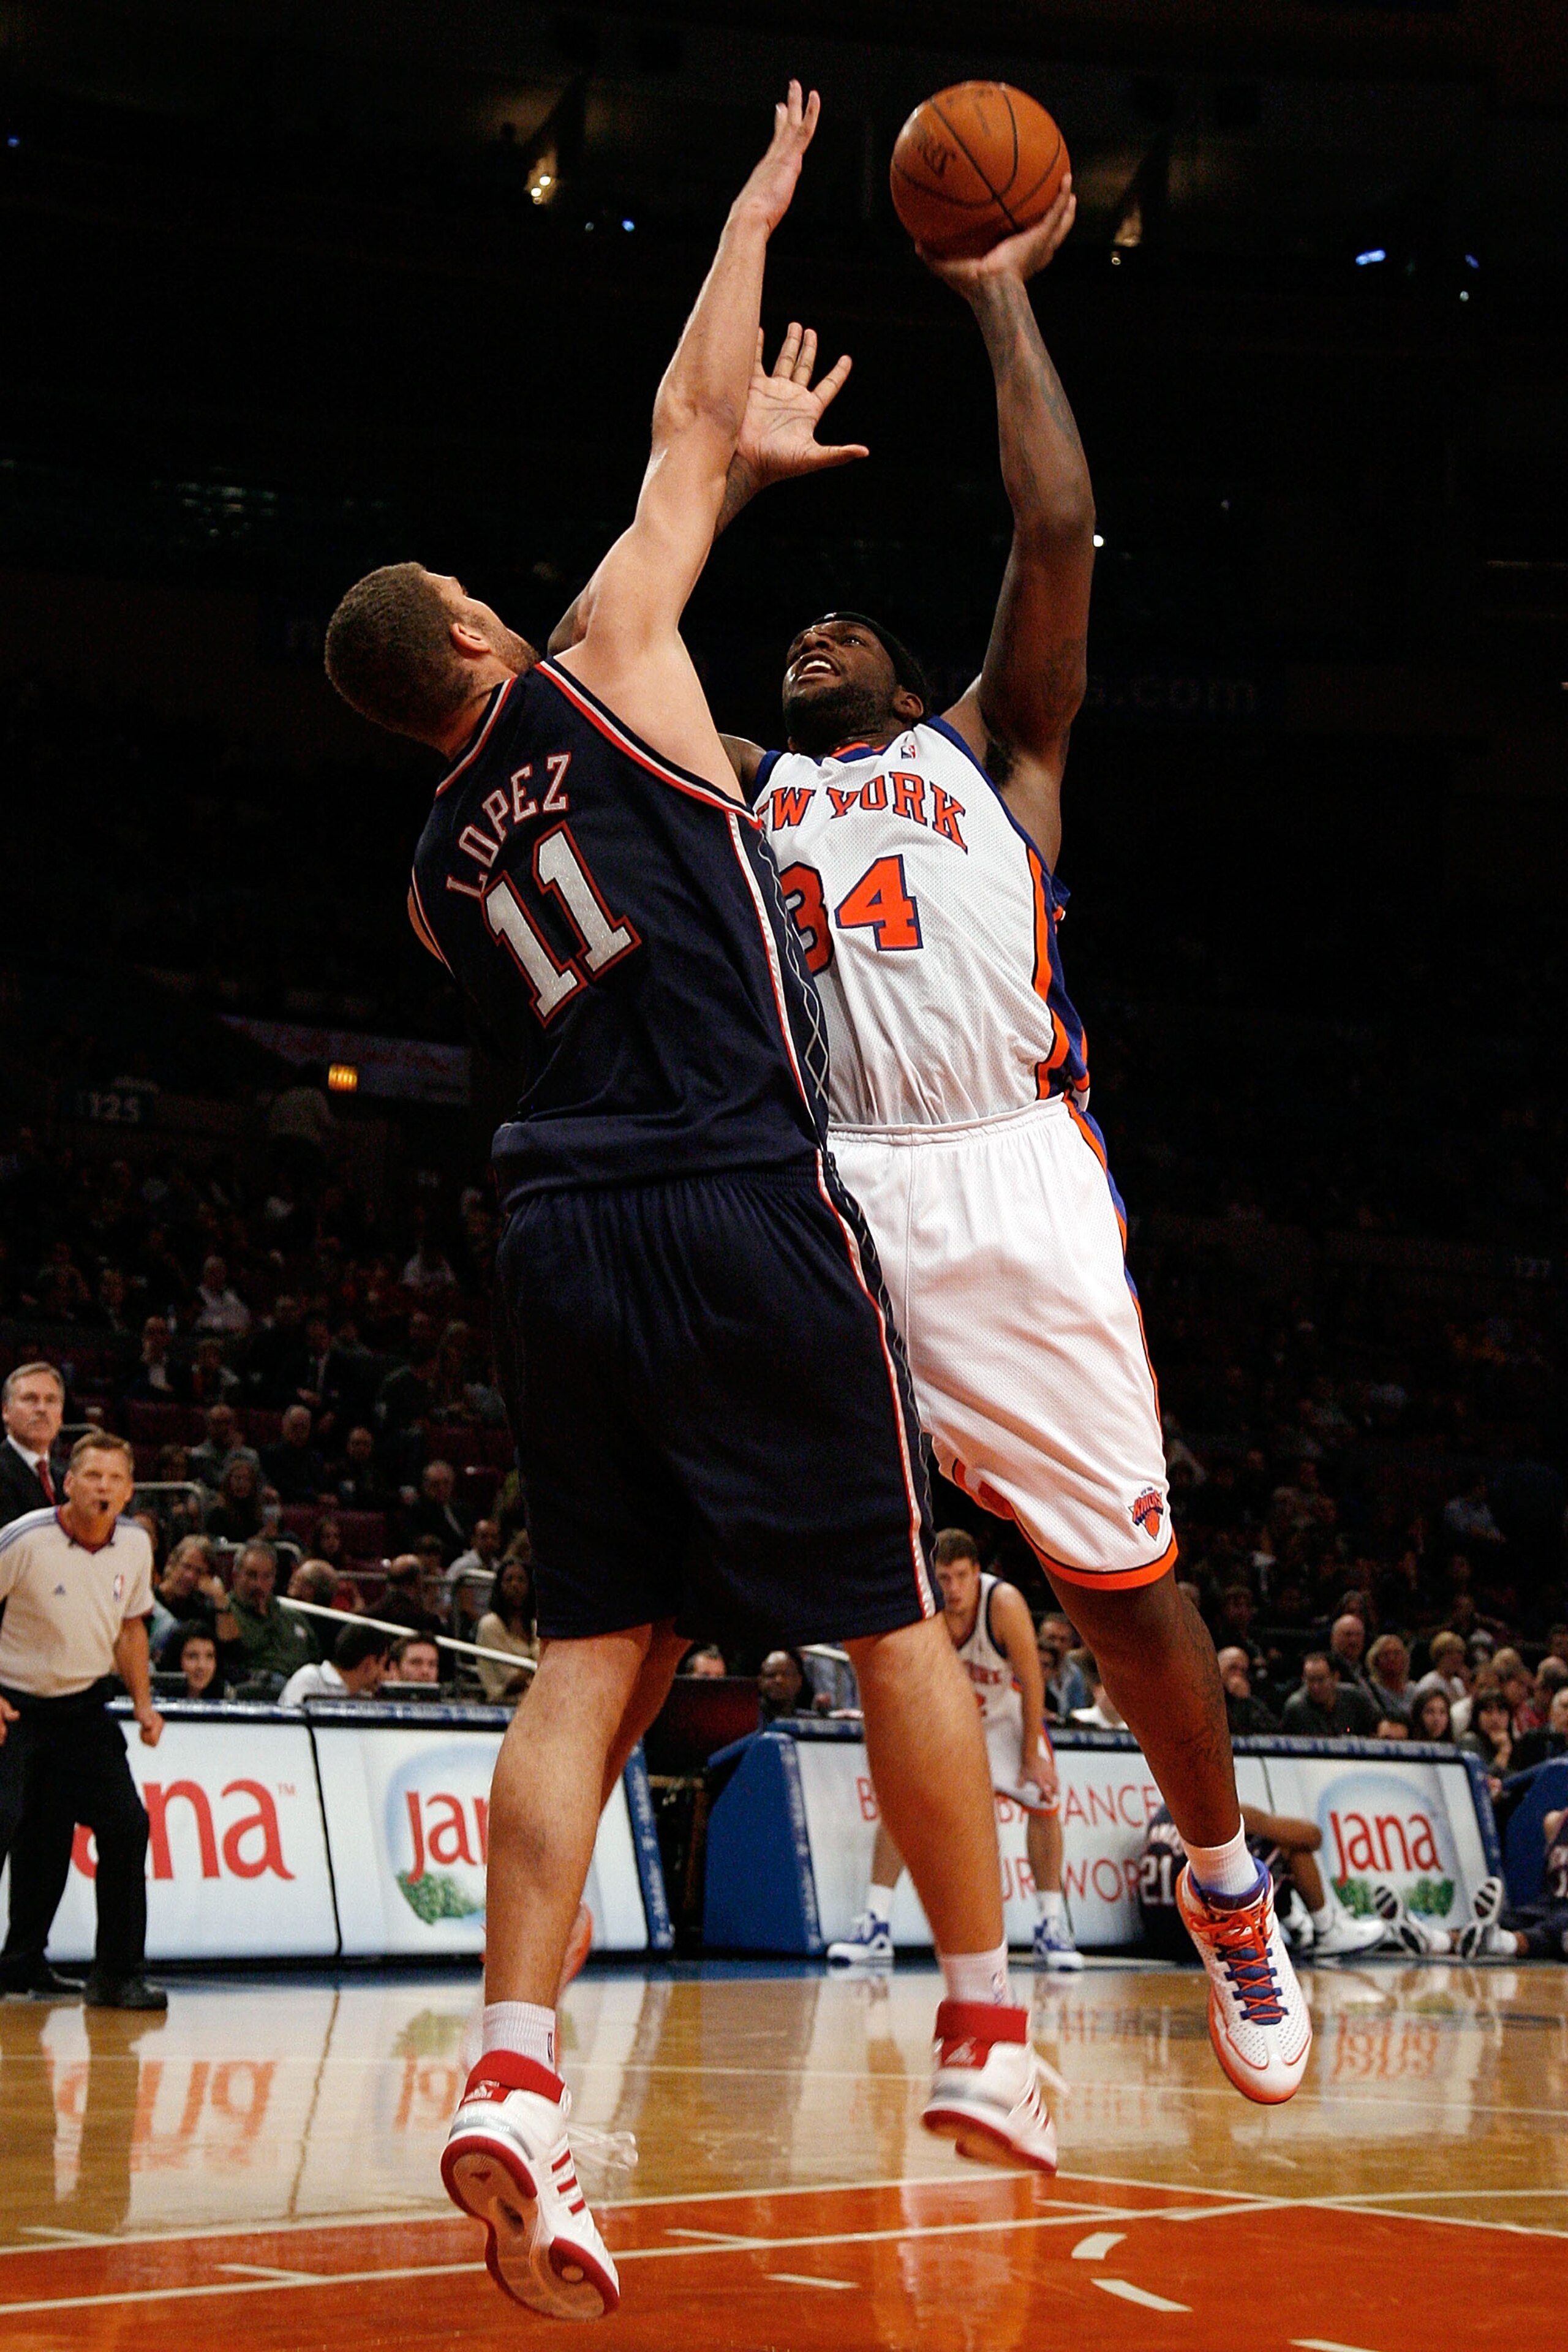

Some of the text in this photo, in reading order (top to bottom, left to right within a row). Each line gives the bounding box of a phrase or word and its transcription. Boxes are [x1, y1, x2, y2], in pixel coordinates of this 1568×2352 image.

[445, 750, 572, 900] LOPEZ
[756, 771, 968, 856] W YORK
[481, 819, 642, 1030] 11
[778, 853, 924, 976] 34
[70, 1779, 296, 1880] na
[995, 1783, 1159, 1828] BANCE
[1063, 1856, 1140, 1902] WOR
[1140, 1855, 1176, 1904] 21
[1330, 1810, 1444, 1888] Jana
